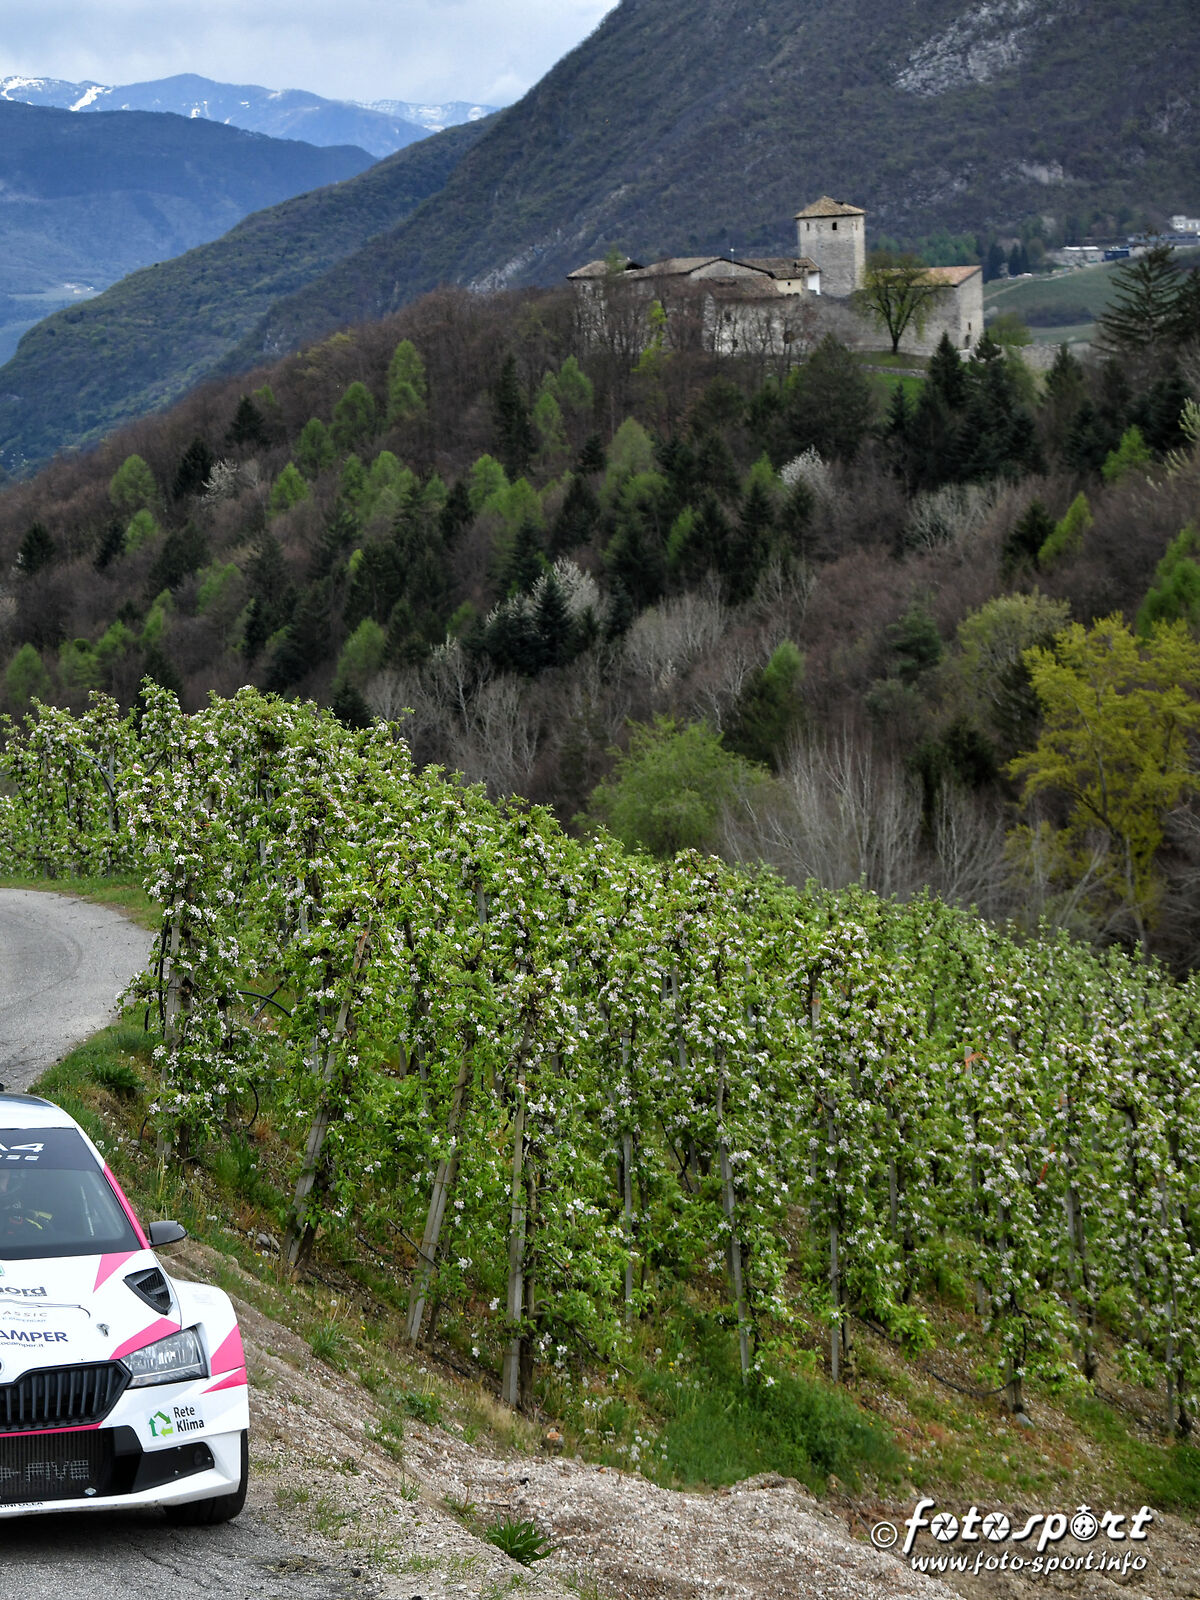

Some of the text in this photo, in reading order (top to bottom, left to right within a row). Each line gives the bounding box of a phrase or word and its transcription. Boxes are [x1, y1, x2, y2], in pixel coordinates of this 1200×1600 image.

[173, 1406, 195, 1419] Rete
[176, 1419, 205, 1433] Klima
[25, 1459, 90, 1482] FIVE
